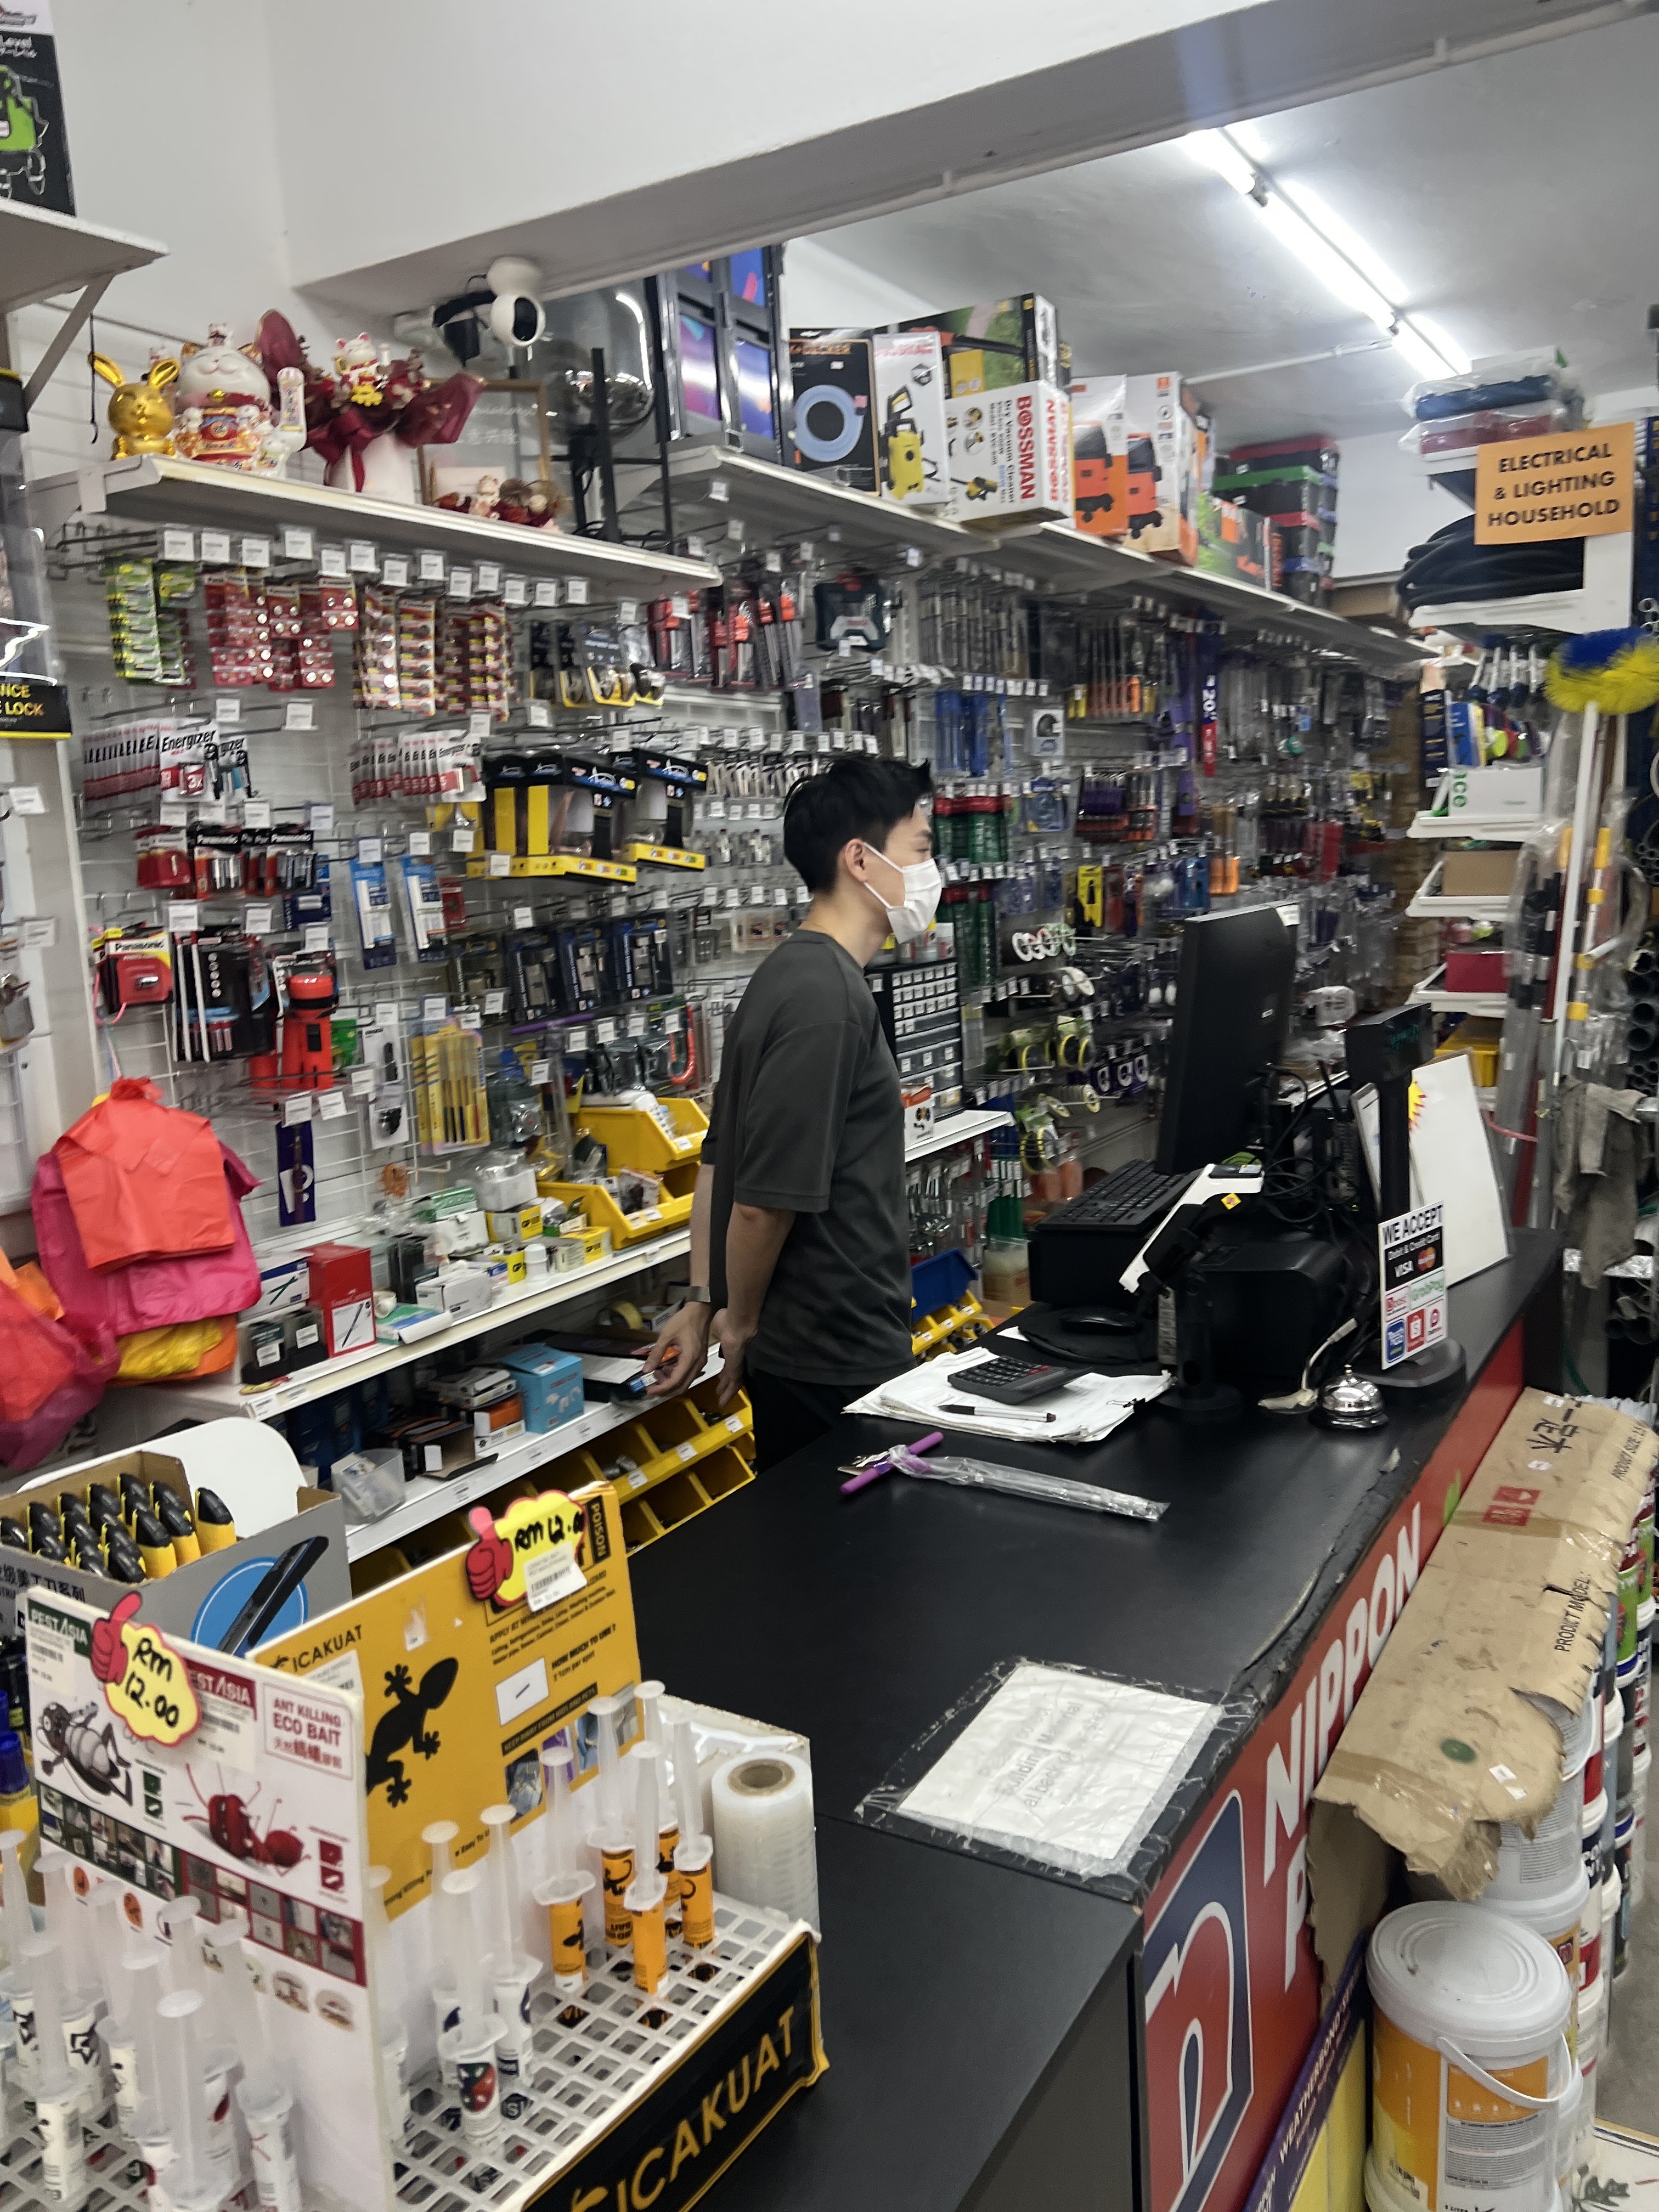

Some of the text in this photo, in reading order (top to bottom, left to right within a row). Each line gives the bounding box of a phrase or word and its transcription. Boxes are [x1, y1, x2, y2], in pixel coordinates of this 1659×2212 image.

[1017, 396, 1036, 500] BOSSMAN
[1498, 443, 1614, 473] ELECTRICAL
[1494, 470, 1617, 500] & LIGHTING
[1487, 498, 1620, 527] HOUSEHOLD
[4, 701, 44, 716] LOCK
[162, 730, 217, 753] Energizer
[1383, 1204, 1443, 1245] WE ACCEPT
[1394, 1260, 1414, 1278] VISA
[591, 1503, 607, 1558] POISON
[1554, 1611, 1582, 1652] PRODUCT
[551, 1653, 569, 1670] HOW
[569, 1640, 590, 1658] MUCH
[589, 1634, 599, 1646] TO
[125, 1671, 180, 1728] 12.00
[1264, 1500, 1422, 1888] NIPPON
[273, 1697, 342, 1728] ANT KILLING
[273, 1711, 341, 1747] ECO BAIT
